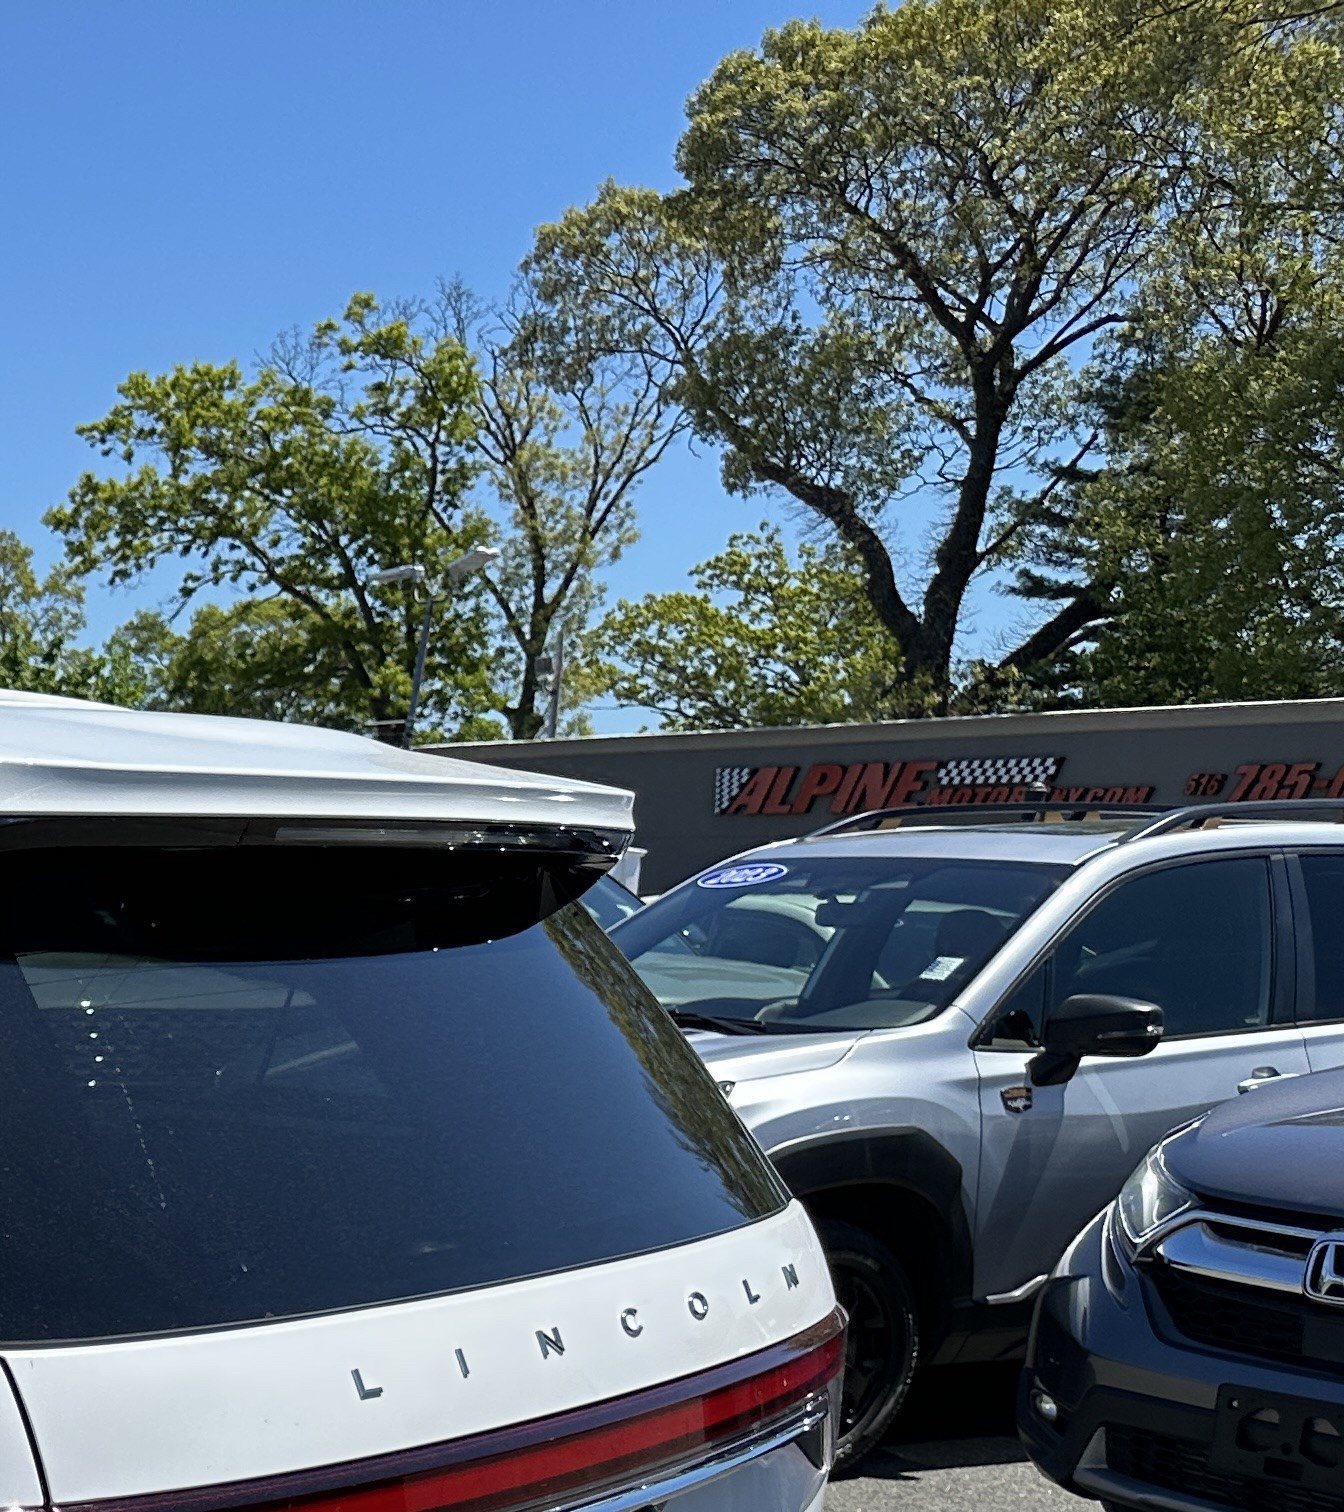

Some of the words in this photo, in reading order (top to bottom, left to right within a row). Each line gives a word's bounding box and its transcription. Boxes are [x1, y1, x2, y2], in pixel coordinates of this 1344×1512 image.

[726, 760, 940, 816] ALPINE
[1184, 773, 1226, 796] 516
[351, 1263, 800, 1401] LINCOLN
